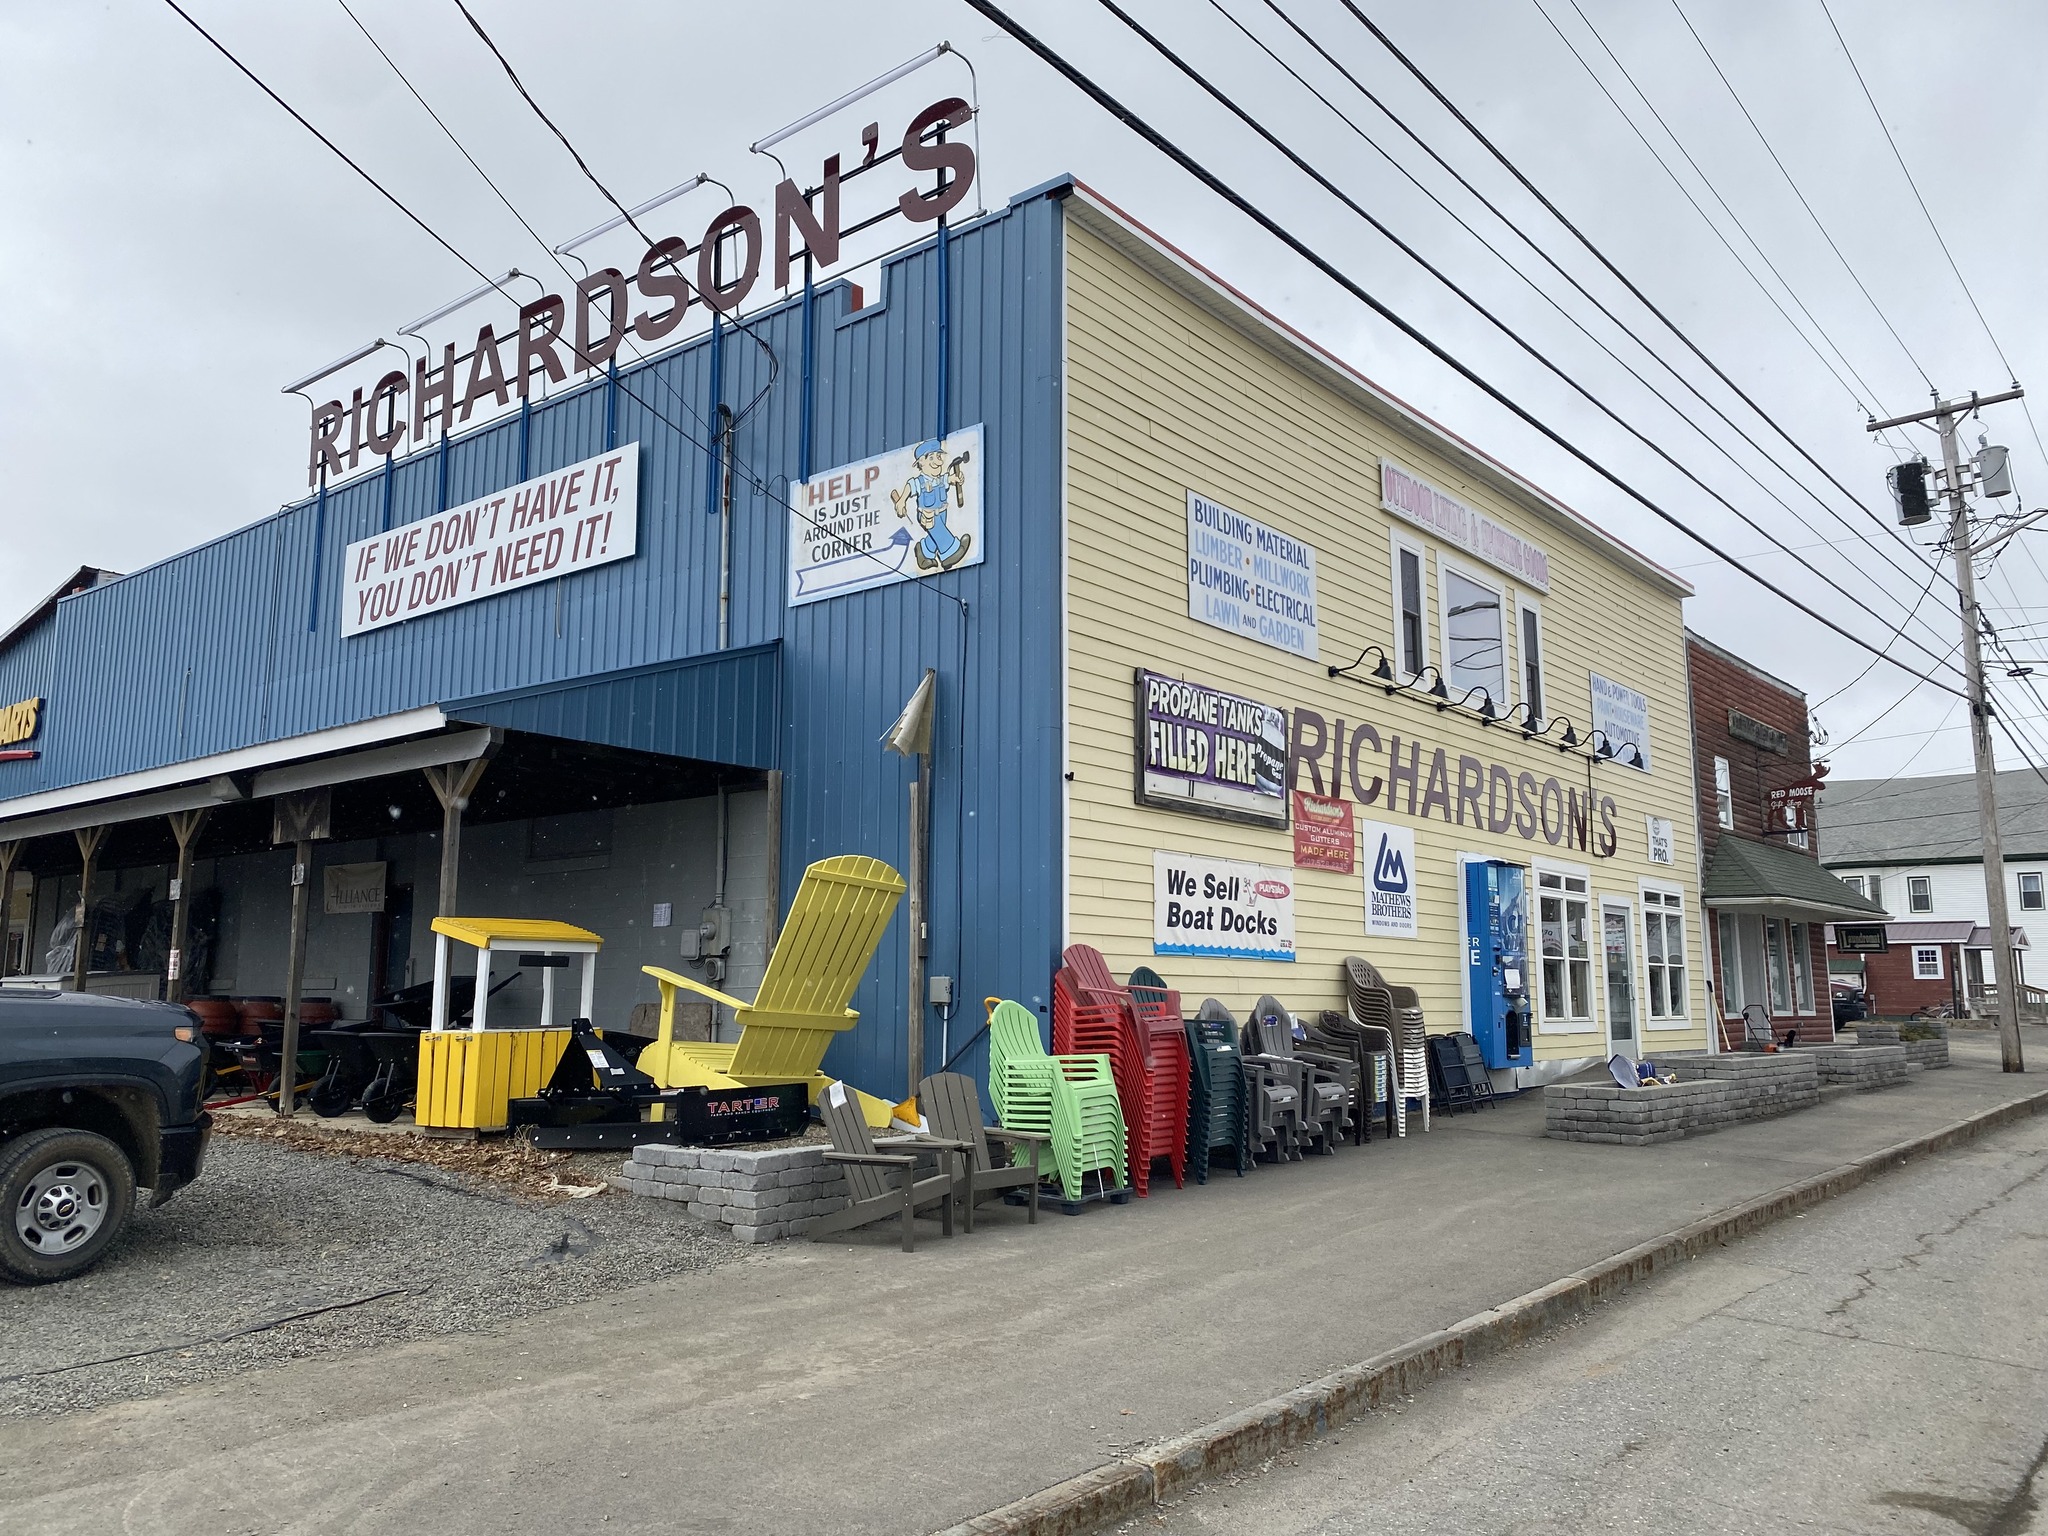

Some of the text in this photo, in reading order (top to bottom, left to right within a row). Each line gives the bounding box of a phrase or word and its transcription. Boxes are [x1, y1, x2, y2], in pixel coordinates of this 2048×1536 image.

[308, 97, 976, 487] RICHARDSON'S
[808, 465, 880, 507] HELP
[355, 456, 622, 583] IF WE DON'T HAVE IT,
[814, 494, 871, 523] IS JUST
[803, 509, 881, 544] AROUND THE
[1194, 499, 1310, 570] BUILDING MATERIAL
[811, 532, 872, 563] CORNER
[1195, 529, 1311, 598] LUMBER MILLWORK
[357, 510, 613, 626] YOU DON'T NEED IT!
[1191, 558, 1316, 627] PLUMBING ELECTRICAL
[1205, 594, 1305, 651] LAWN AND GARDEN
[0, 697, 39, 745] ARTS
[1149, 680, 1263, 737] PROPANE TANKS
[1604, 720, 1641, 748] AUTOMOTIVE
[1150, 719, 1256, 785] FILLED HERE
[1256, 743, 1284, 771] Propane
[1290, 707, 1617, 857] RICHARDSON'S
[1770, 786, 1813, 800] RED MOOSE
[1295, 822, 1353, 839] CUSTOM ALUMINUM
[1310, 834, 1340, 845] GUTTERS
[1300, 845, 1350, 860] MADE HERE
[1167, 868, 1240, 901] We Sell
[1371, 890, 1412, 907] MATHEWS
[1167, 901, 1278, 935] Boat Docks
[1371, 903, 1412, 919] BROTHERS
[1371, 919, 1390, 928] WINDOWS
[707, 1096, 780, 1114] TARTER
